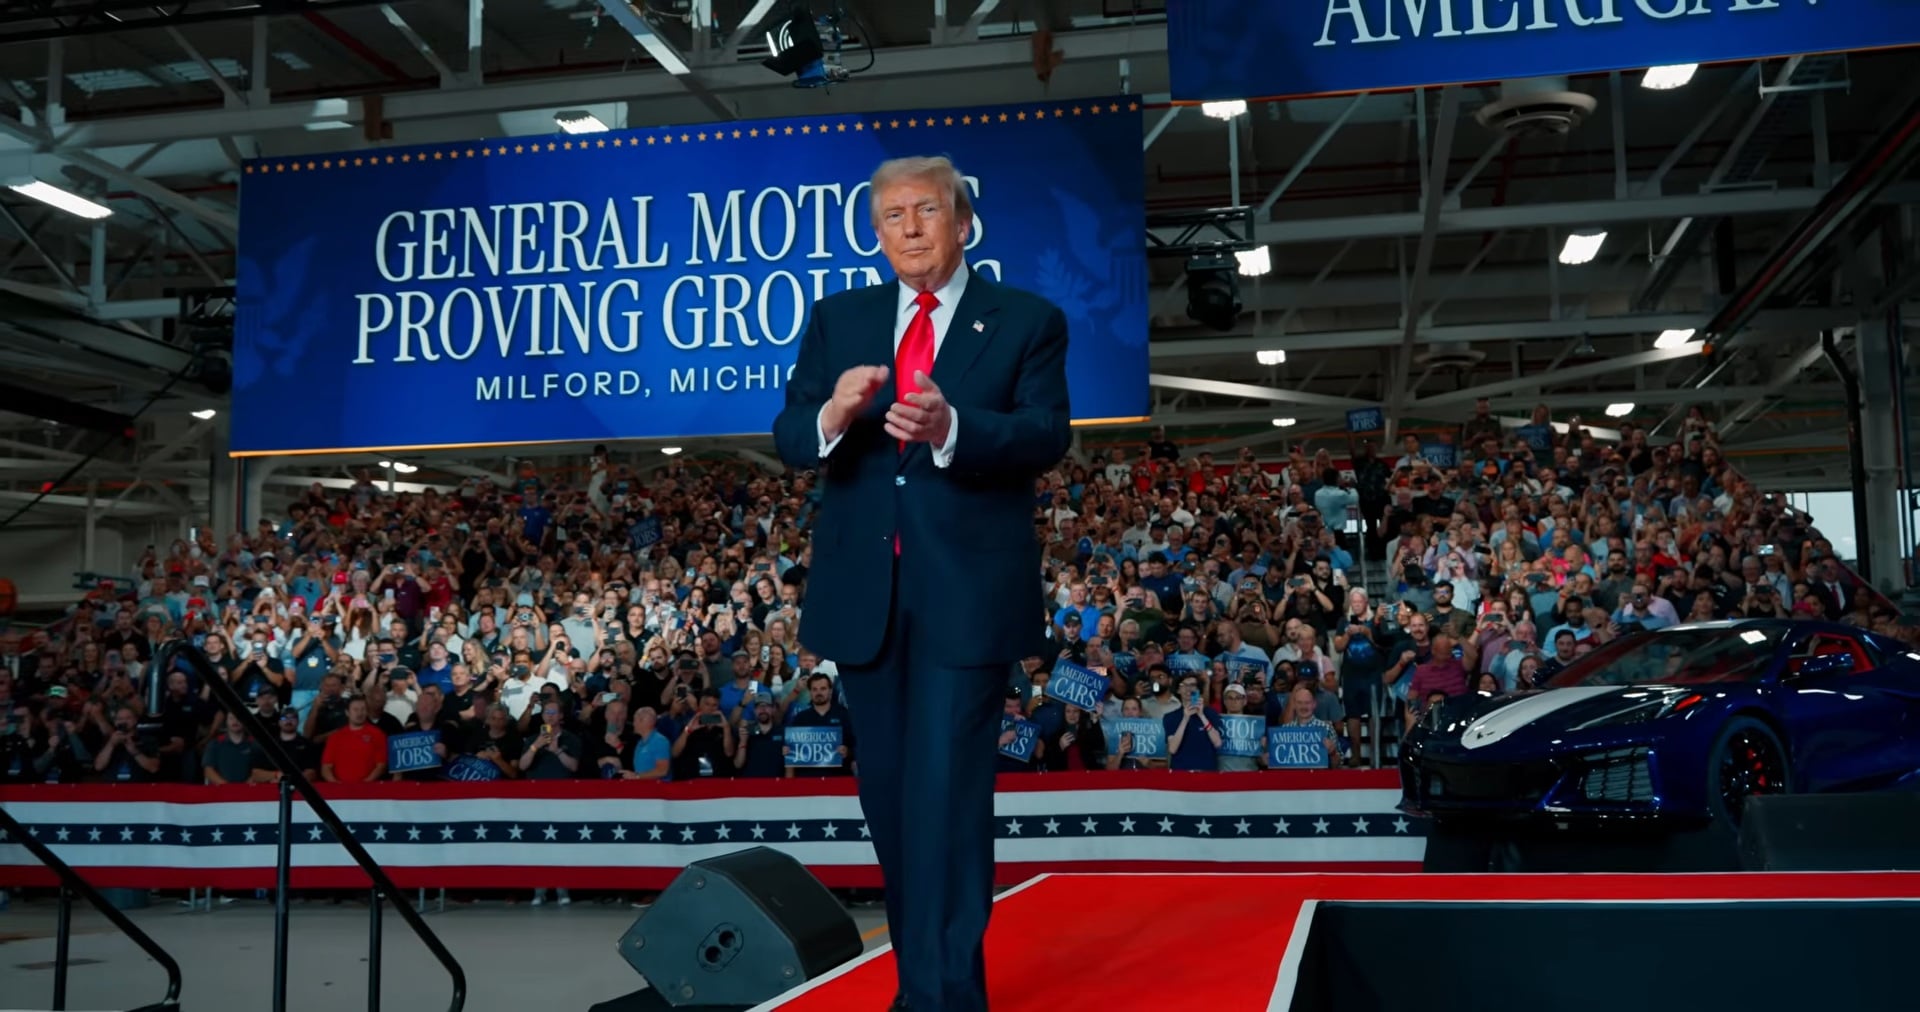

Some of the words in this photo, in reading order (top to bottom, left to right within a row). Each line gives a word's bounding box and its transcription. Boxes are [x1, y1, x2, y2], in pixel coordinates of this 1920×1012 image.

[375, 197, 669, 282] GENERAL
[686, 175, 983, 265] MOTOS
[351, 278, 644, 364] PROVING
[475, 369, 651, 400] MILFORD,
[669, 363, 797, 393] MICHI
[1059, 664, 1104, 690] AMERICAN
[1054, 676, 1098, 708] CARS
[790, 731, 837, 742] AMERICAN
[1113, 721, 1162, 735] AMERICAN
[1272, 730, 1321, 743] AMERICAN
[393, 735, 435, 748] AMERICAN
[396, 745, 433, 768] JOBS
[792, 743, 833, 763] JOBS
[1274, 743, 1321, 764] CARS
